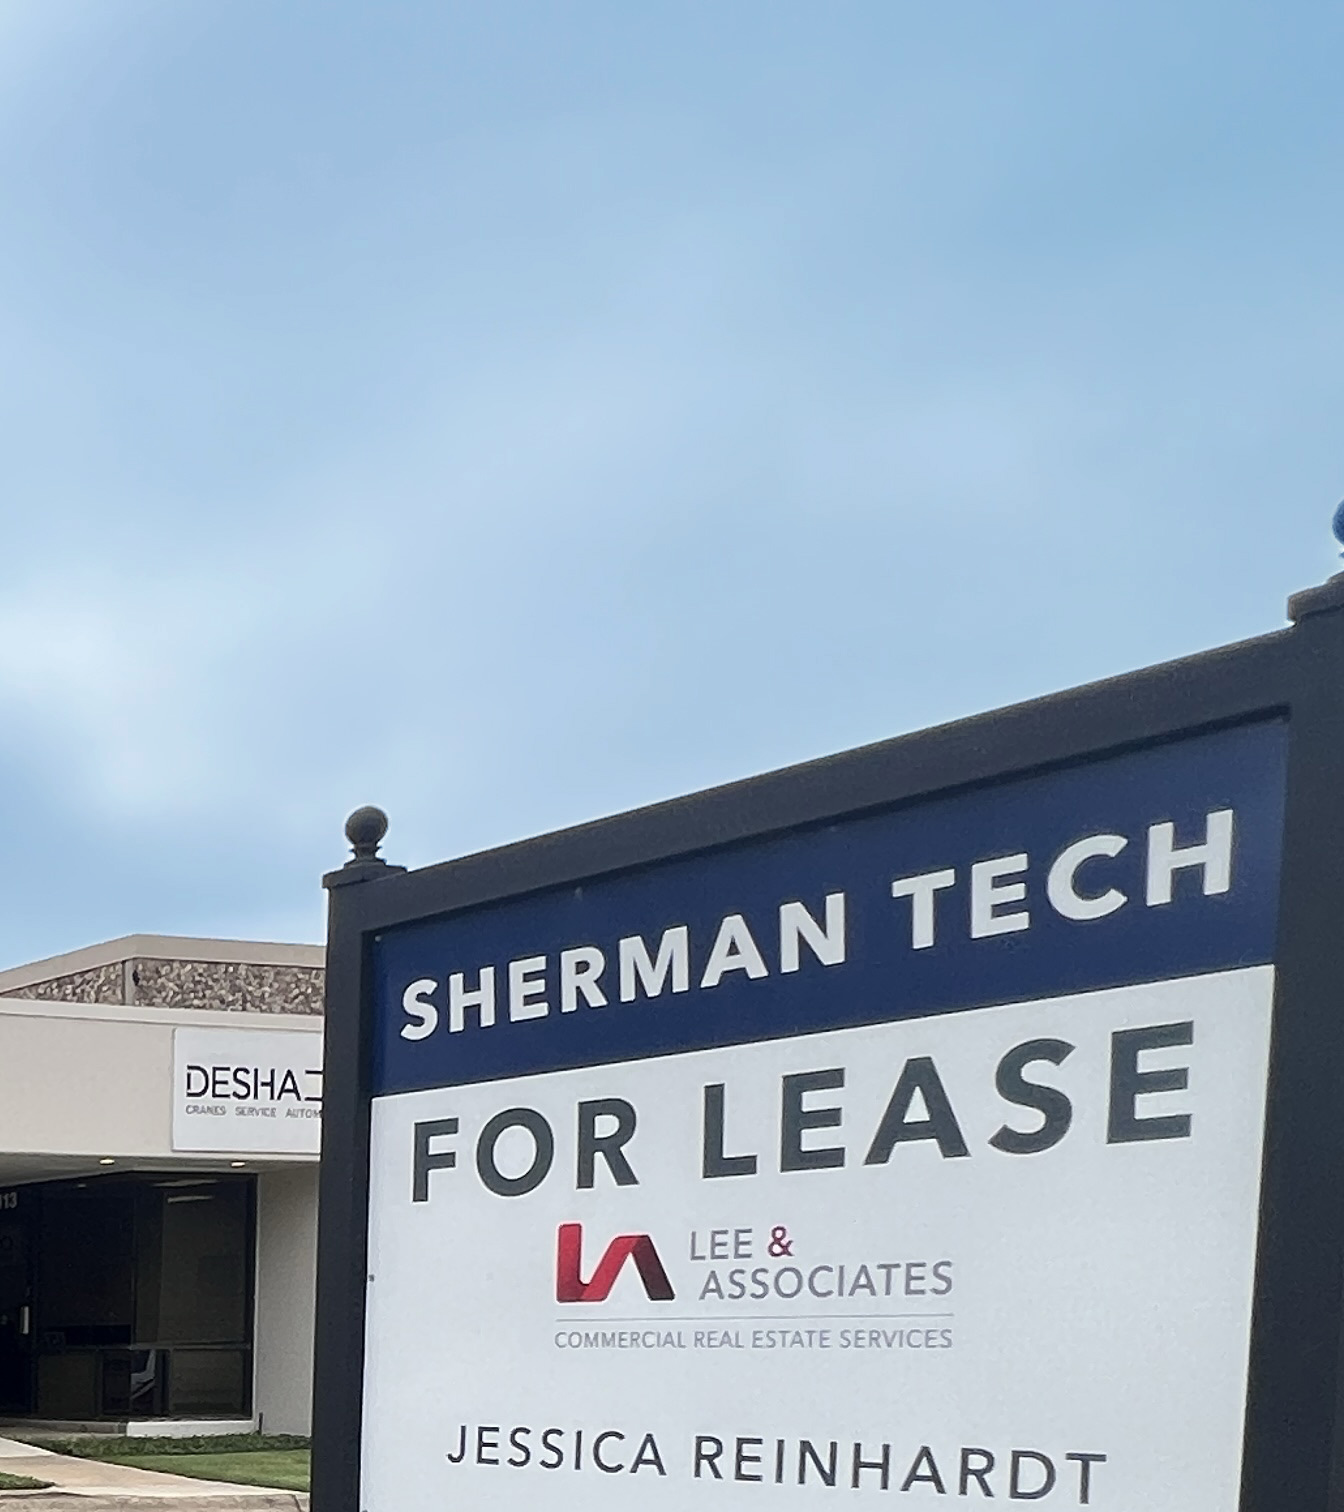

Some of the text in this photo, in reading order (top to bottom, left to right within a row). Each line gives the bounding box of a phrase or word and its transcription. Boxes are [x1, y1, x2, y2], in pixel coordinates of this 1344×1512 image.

[398, 808, 1235, 1041] SHERMAN TECH
[234, 1106, 277, 1118] SERVICE
[410, 1019, 1195, 1203] FOR LEASE
[689, 1225, 795, 1261] LEE &
[698, 1260, 954, 1301] ASSOCIATES
[553, 1328, 954, 1350] COMMERCIAL REAL ESTATE SERVICES
[446, 1424, 1108, 1506] JESSICA REINHARDT
